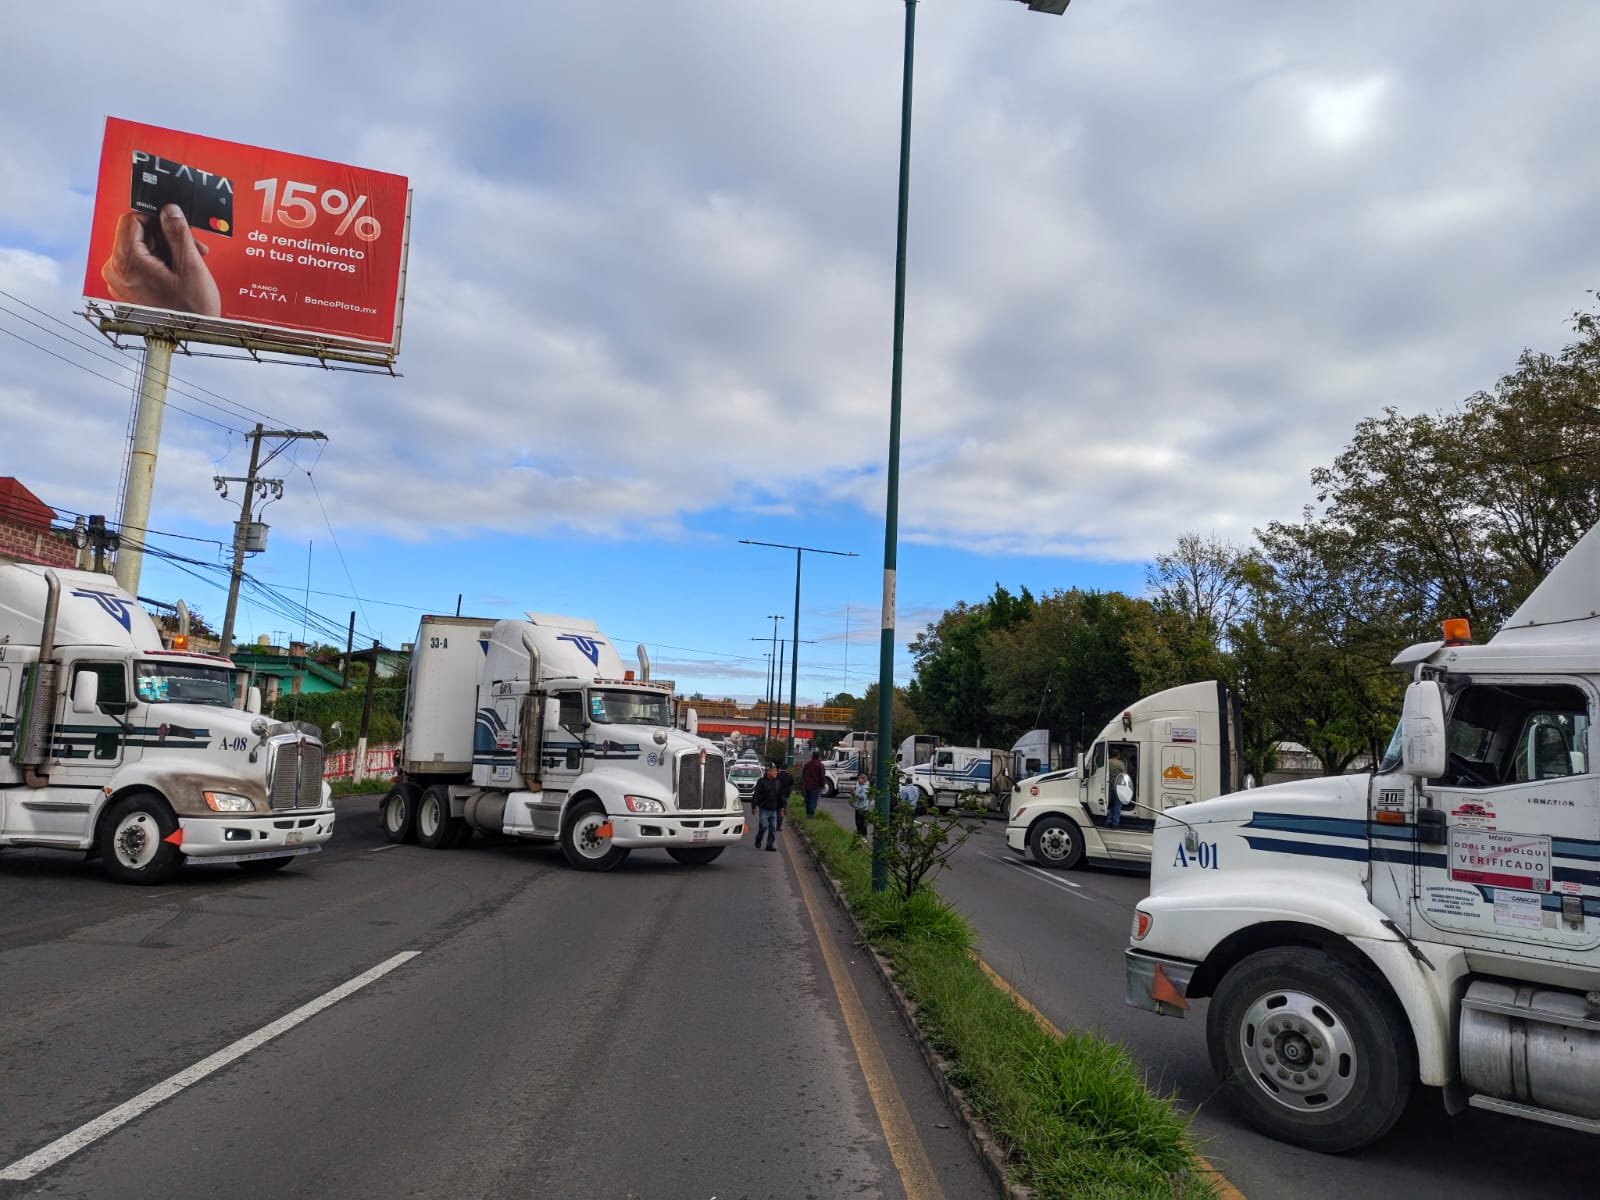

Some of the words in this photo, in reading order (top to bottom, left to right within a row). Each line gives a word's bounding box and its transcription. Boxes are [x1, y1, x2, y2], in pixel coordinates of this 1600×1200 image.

[132, 150, 233, 194] PLATA
[254, 178, 381, 242] 15%
[247, 230, 268, 243] de
[272, 235, 365, 260] rendimiento
[245, 246, 265, 258] en
[269, 249, 294, 263] tus
[297, 254, 356, 273] ahorros
[239, 288, 287, 303] PLATA
[251, 283, 278, 292] BANCO
[304, 296, 377, 315] BancoPlata.mx
[430, 637, 448, 649] 33-A
[219, 736, 248, 751] A-08
[1488, 834, 1513, 842] MÉXICO
[1172, 841, 1221, 870] A-01
[1454, 841, 1486, 851] DOBLE
[1490, 845, 1548, 857] REMOLQUE
[1460, 854, 1544, 871] VERIFICADO
